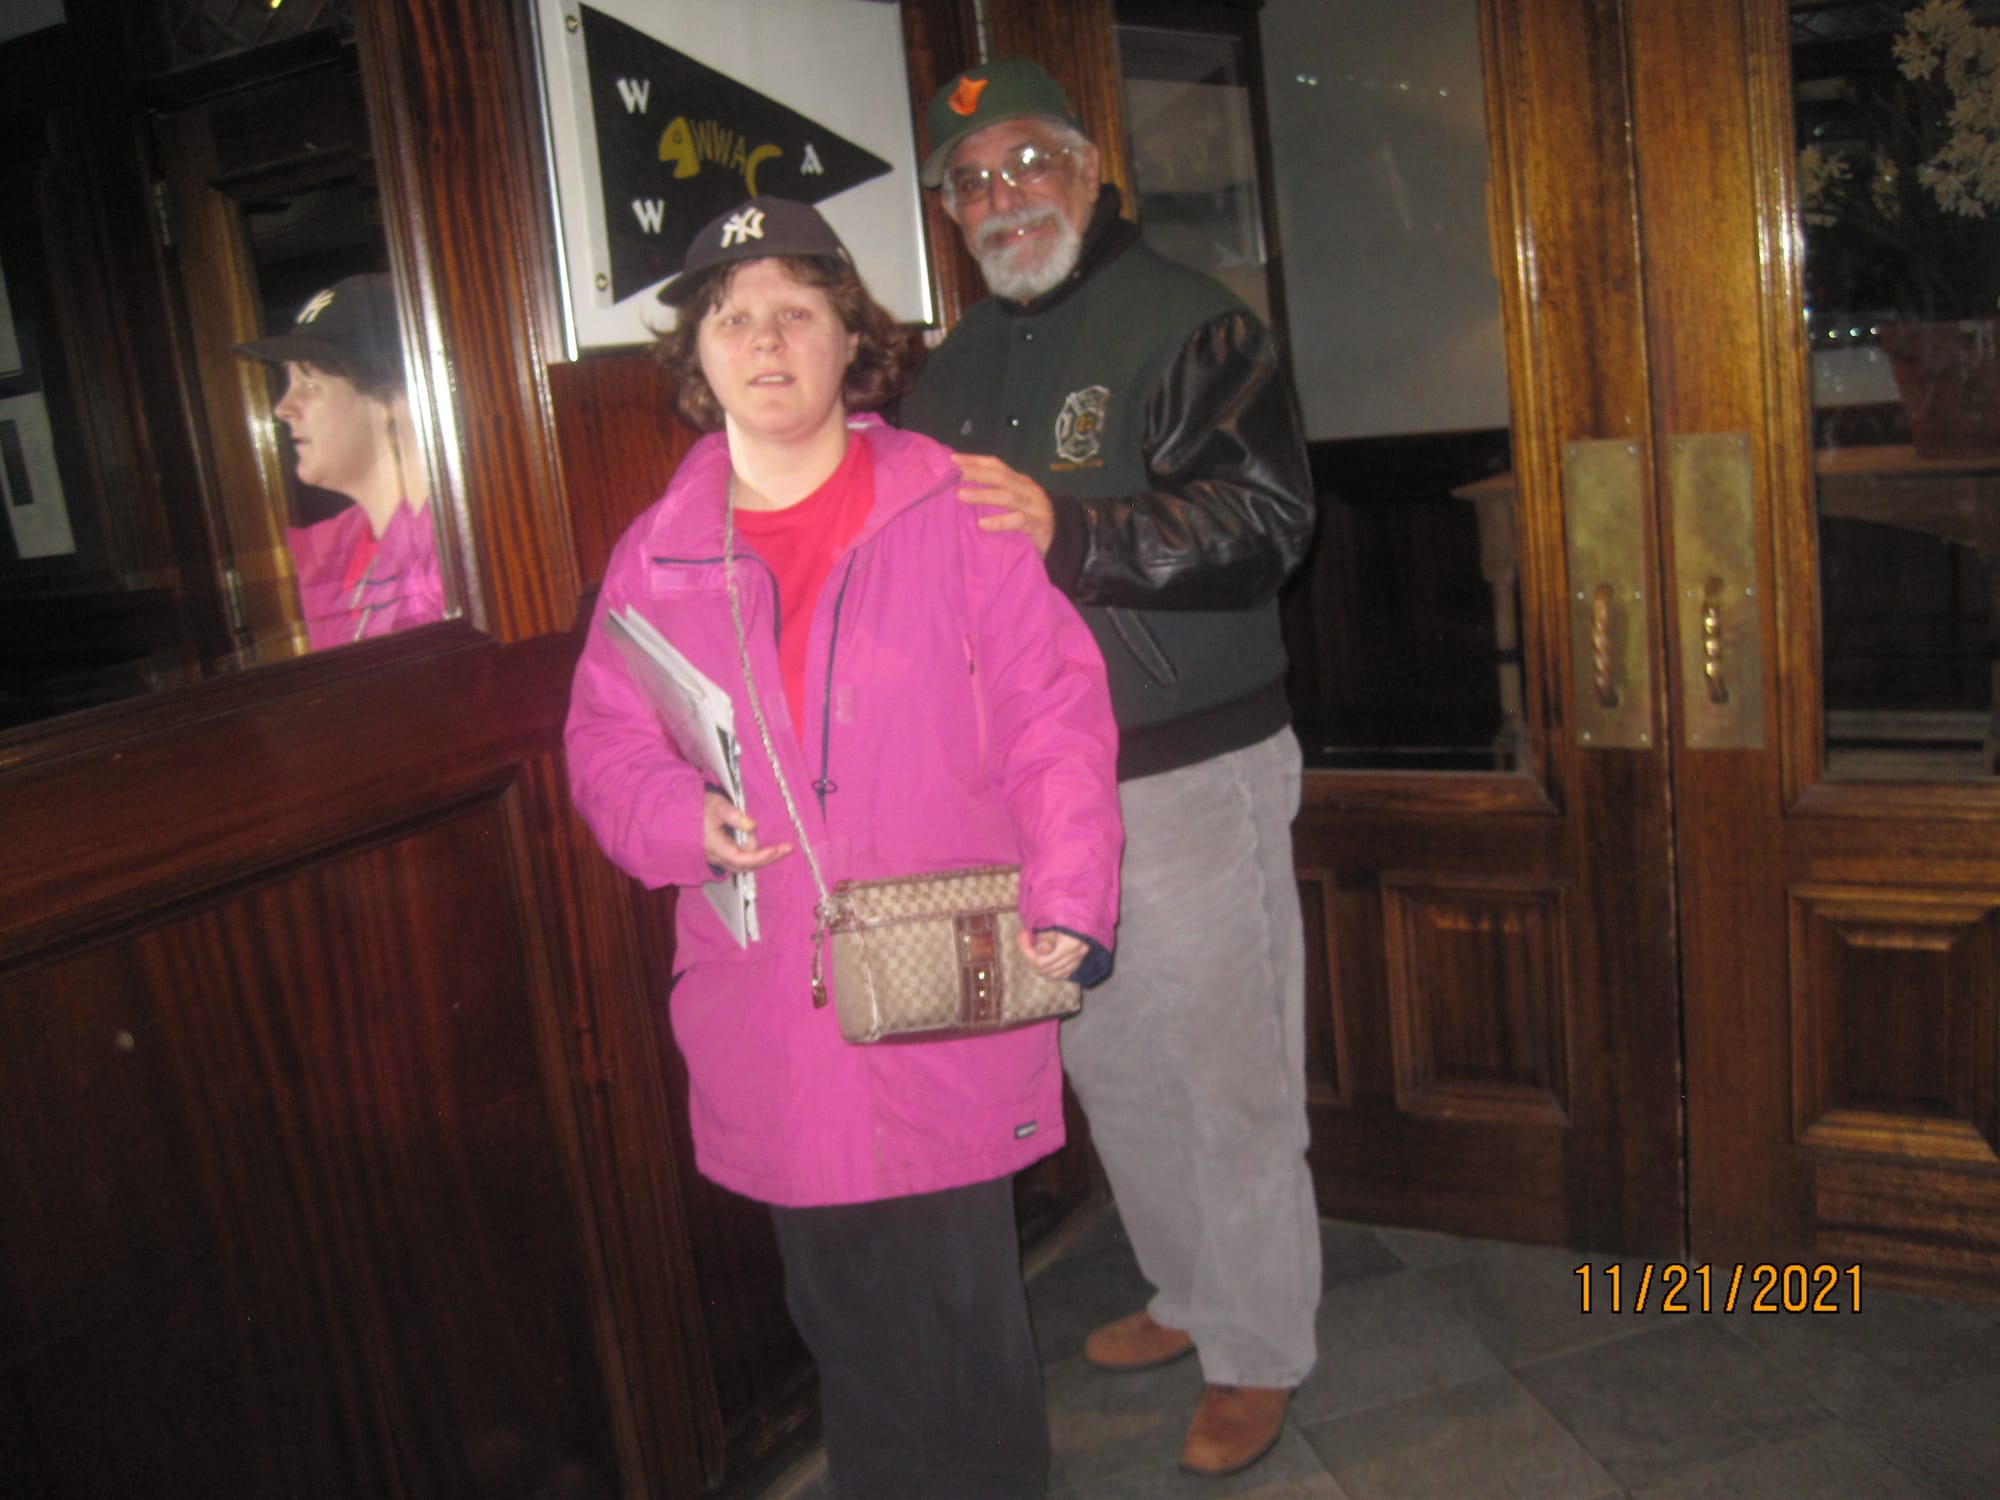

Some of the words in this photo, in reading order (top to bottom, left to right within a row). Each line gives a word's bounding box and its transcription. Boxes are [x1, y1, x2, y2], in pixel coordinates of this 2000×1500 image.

[617, 78, 650, 114] W
[801, 143, 824, 175] A
[632, 199, 665, 234] W
[721, 207, 766, 248] NY
